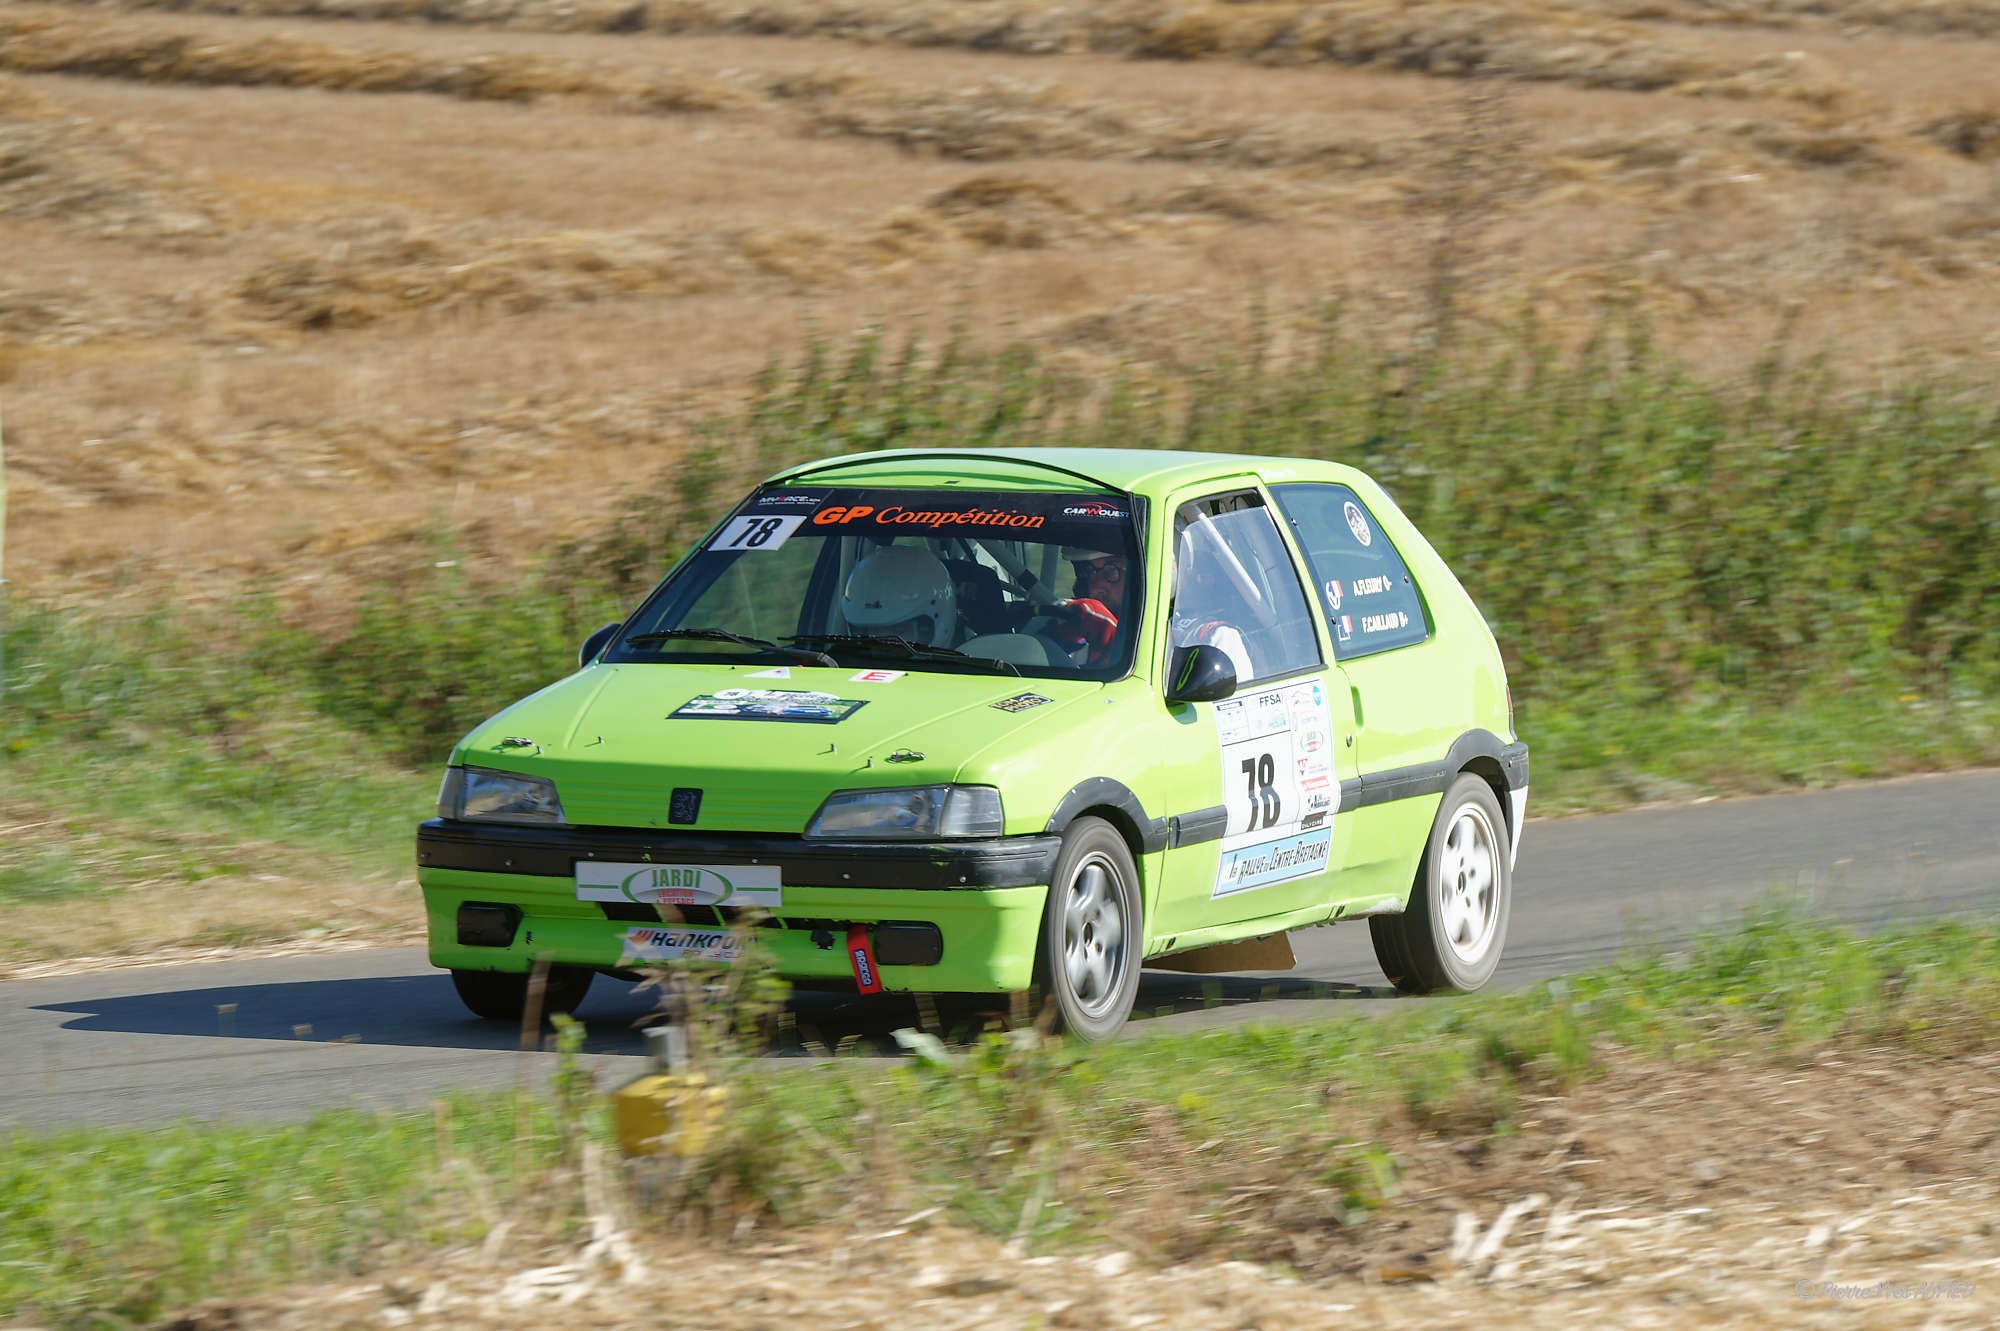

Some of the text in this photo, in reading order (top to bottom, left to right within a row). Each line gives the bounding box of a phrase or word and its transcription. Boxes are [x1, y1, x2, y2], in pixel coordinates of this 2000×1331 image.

[812, 505, 1046, 529] GP Compétition
[729, 517, 784, 548] 78
[861, 671, 893, 682] E
[1259, 693, 1281, 708] FFSA
[1241, 752, 1281, 833] 78
[651, 868, 701, 889] JARDI
